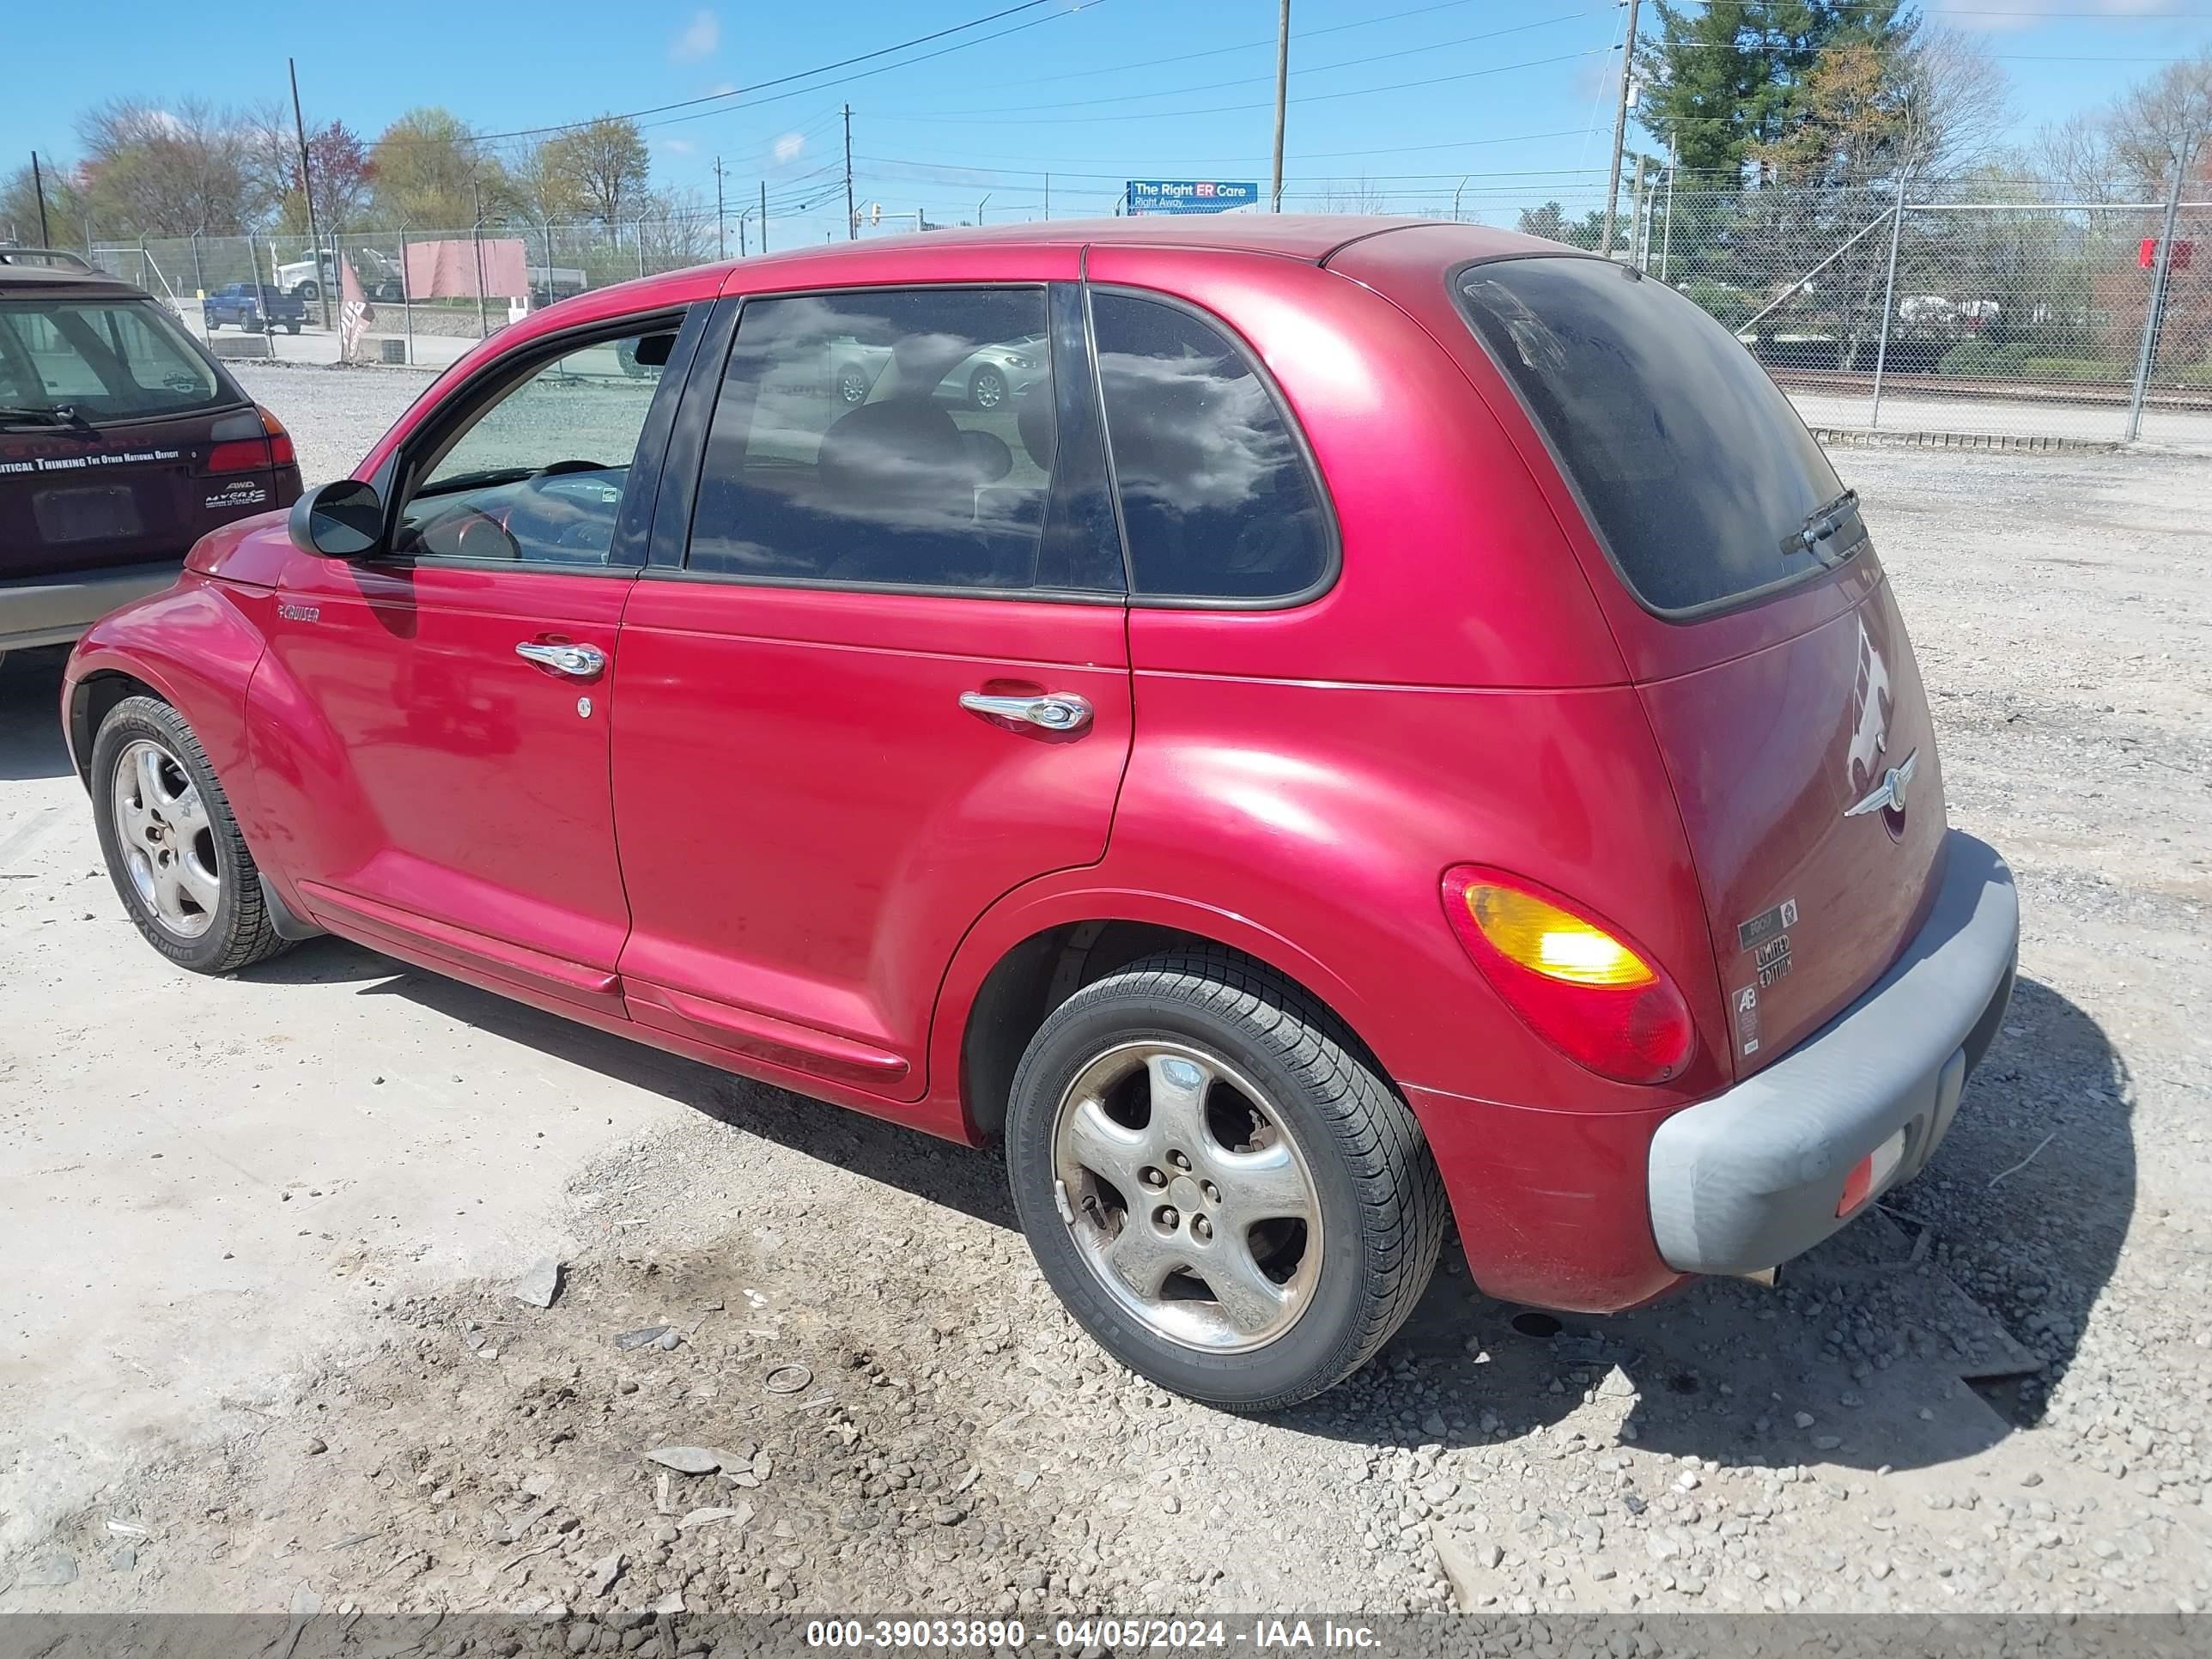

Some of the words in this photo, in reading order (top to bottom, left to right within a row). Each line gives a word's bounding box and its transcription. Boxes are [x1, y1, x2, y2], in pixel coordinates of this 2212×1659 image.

[1134, 183, 1158, 196] The
[1161, 183, 1194, 198] Right
[1196, 184, 1214, 197] ER
[1217, 185, 1246, 197] Care
[1135, 198, 1157, 207] Right
[226, 481, 255, 489] AWD
[1754, 934, 1790, 965] LIMITED
[1759, 957, 1793, 988] EDITION
